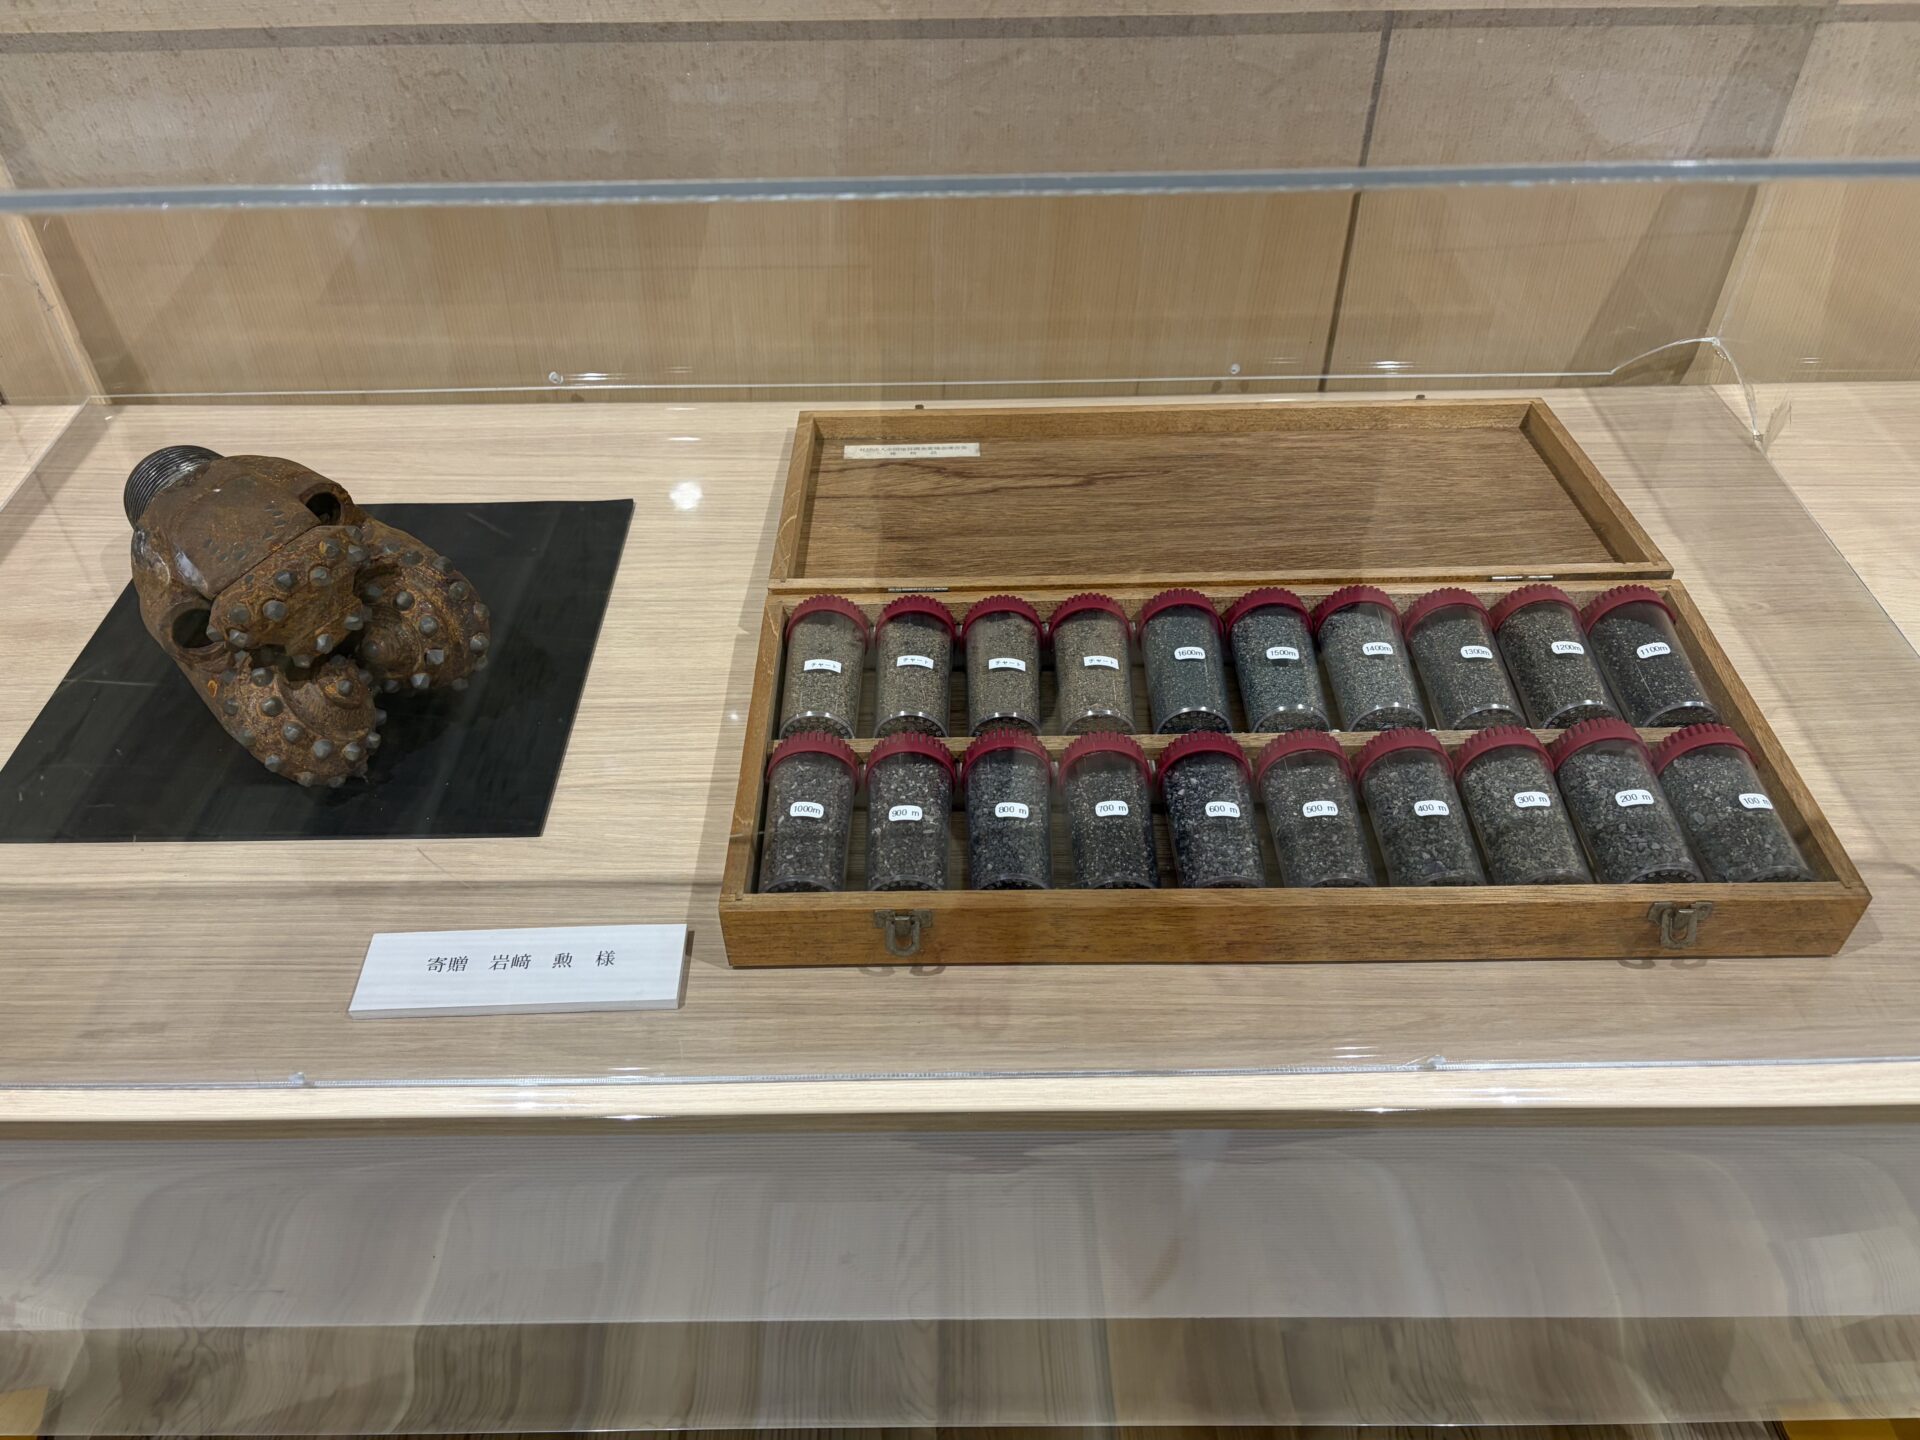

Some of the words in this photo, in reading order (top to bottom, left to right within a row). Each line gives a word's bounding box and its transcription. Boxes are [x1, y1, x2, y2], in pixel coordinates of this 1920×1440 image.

[1177, 649, 1204, 657] 1600m
[1270, 649, 1297, 657] 1500m
[1365, 645, 1392, 653] 1400m
[1464, 648, 1490, 656] 1300m
[1555, 644, 1582, 652] 1200m
[1640, 644, 1668, 656] 1100m
[1517, 794, 1536, 804] 300
[1619, 793, 1638, 804] 200
[1743, 797, 1760, 805] 100
[793, 804, 821, 816] 1000m
[891, 808, 908, 818] 900
[998, 805, 1015, 814] 800
[1097, 803, 1115, 813] 700
[1208, 804, 1226, 813] 600
[1305, 804, 1323, 814] 500
[1417, 803, 1435, 813] 400
[426, 955, 469, 973] 寄贈
[552, 952, 573, 969] 勲
[595, 950, 616, 967] 様
